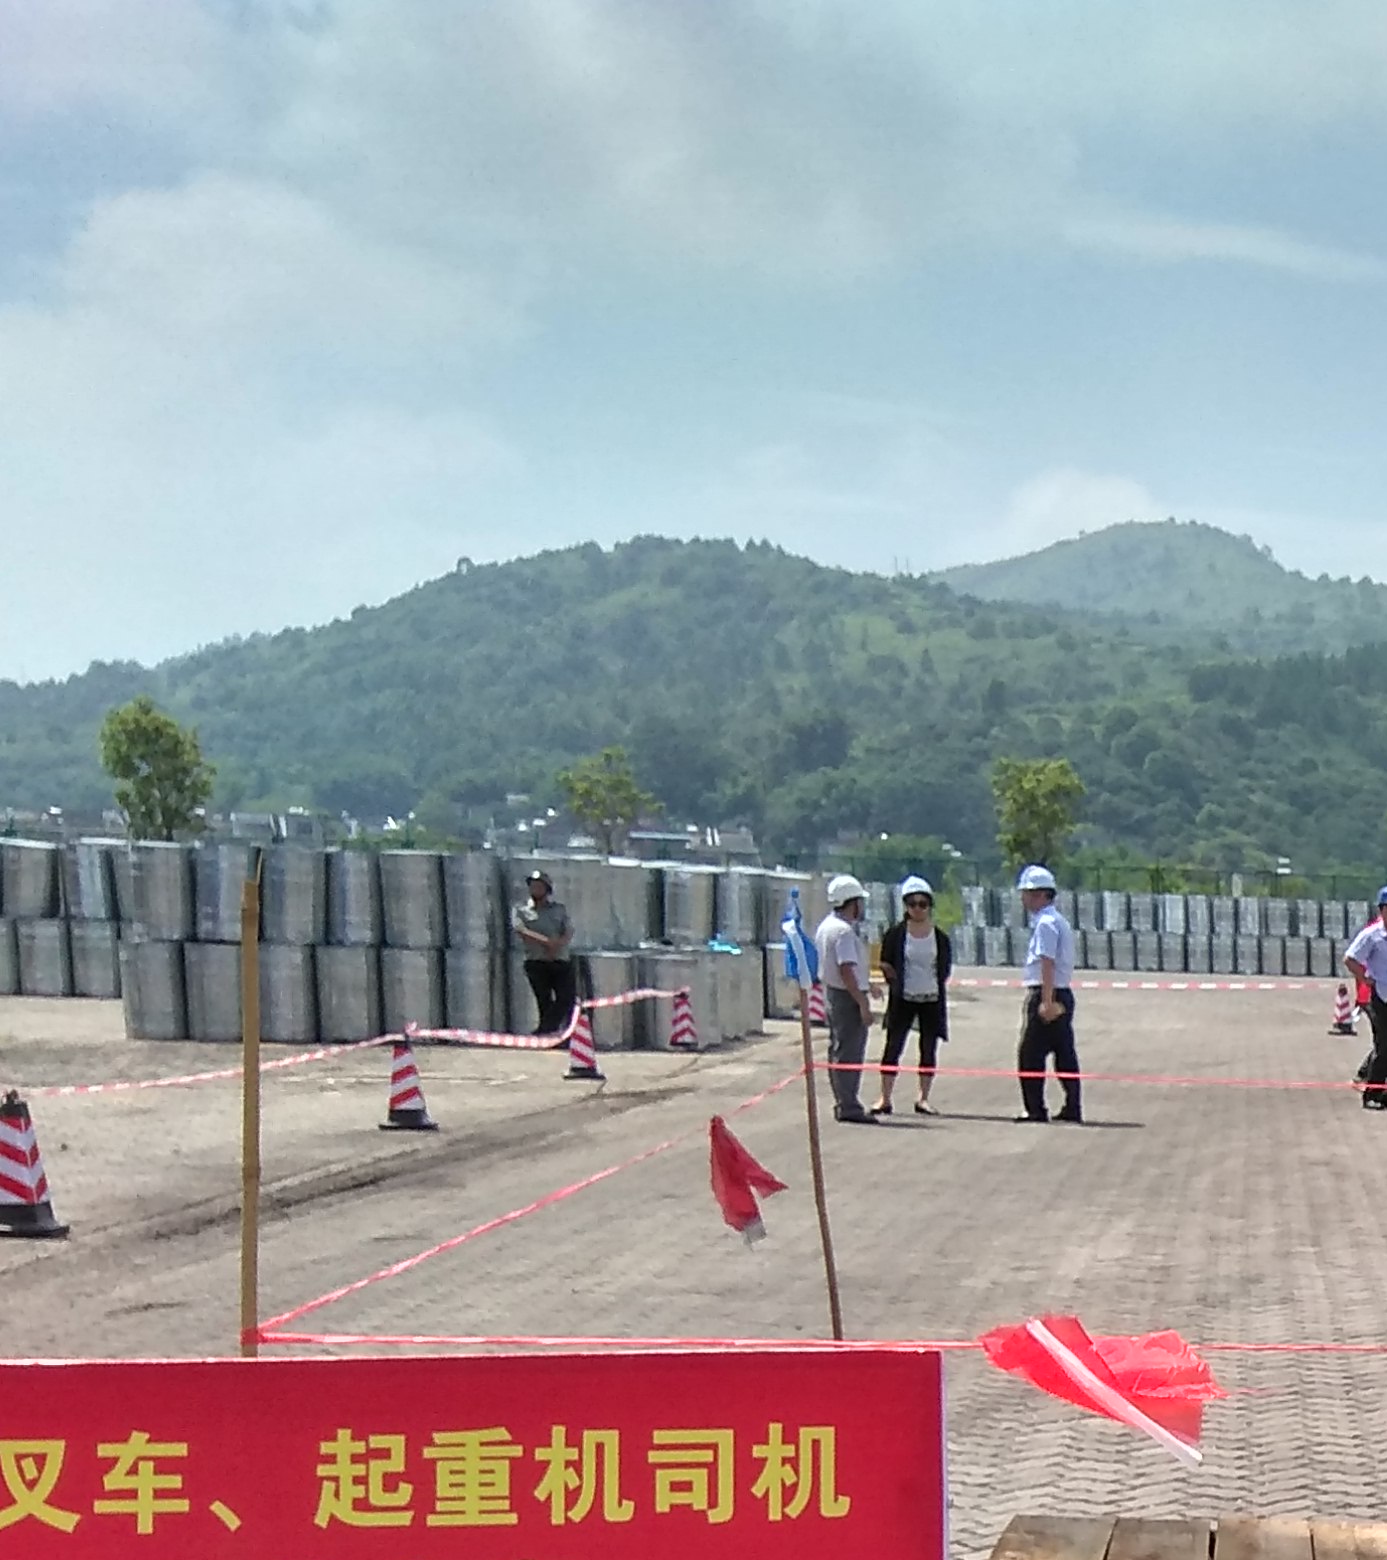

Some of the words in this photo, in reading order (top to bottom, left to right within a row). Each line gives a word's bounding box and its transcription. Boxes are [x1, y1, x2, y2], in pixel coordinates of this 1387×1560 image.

[0, 1422, 851, 1534] 叉车、起重机司机
